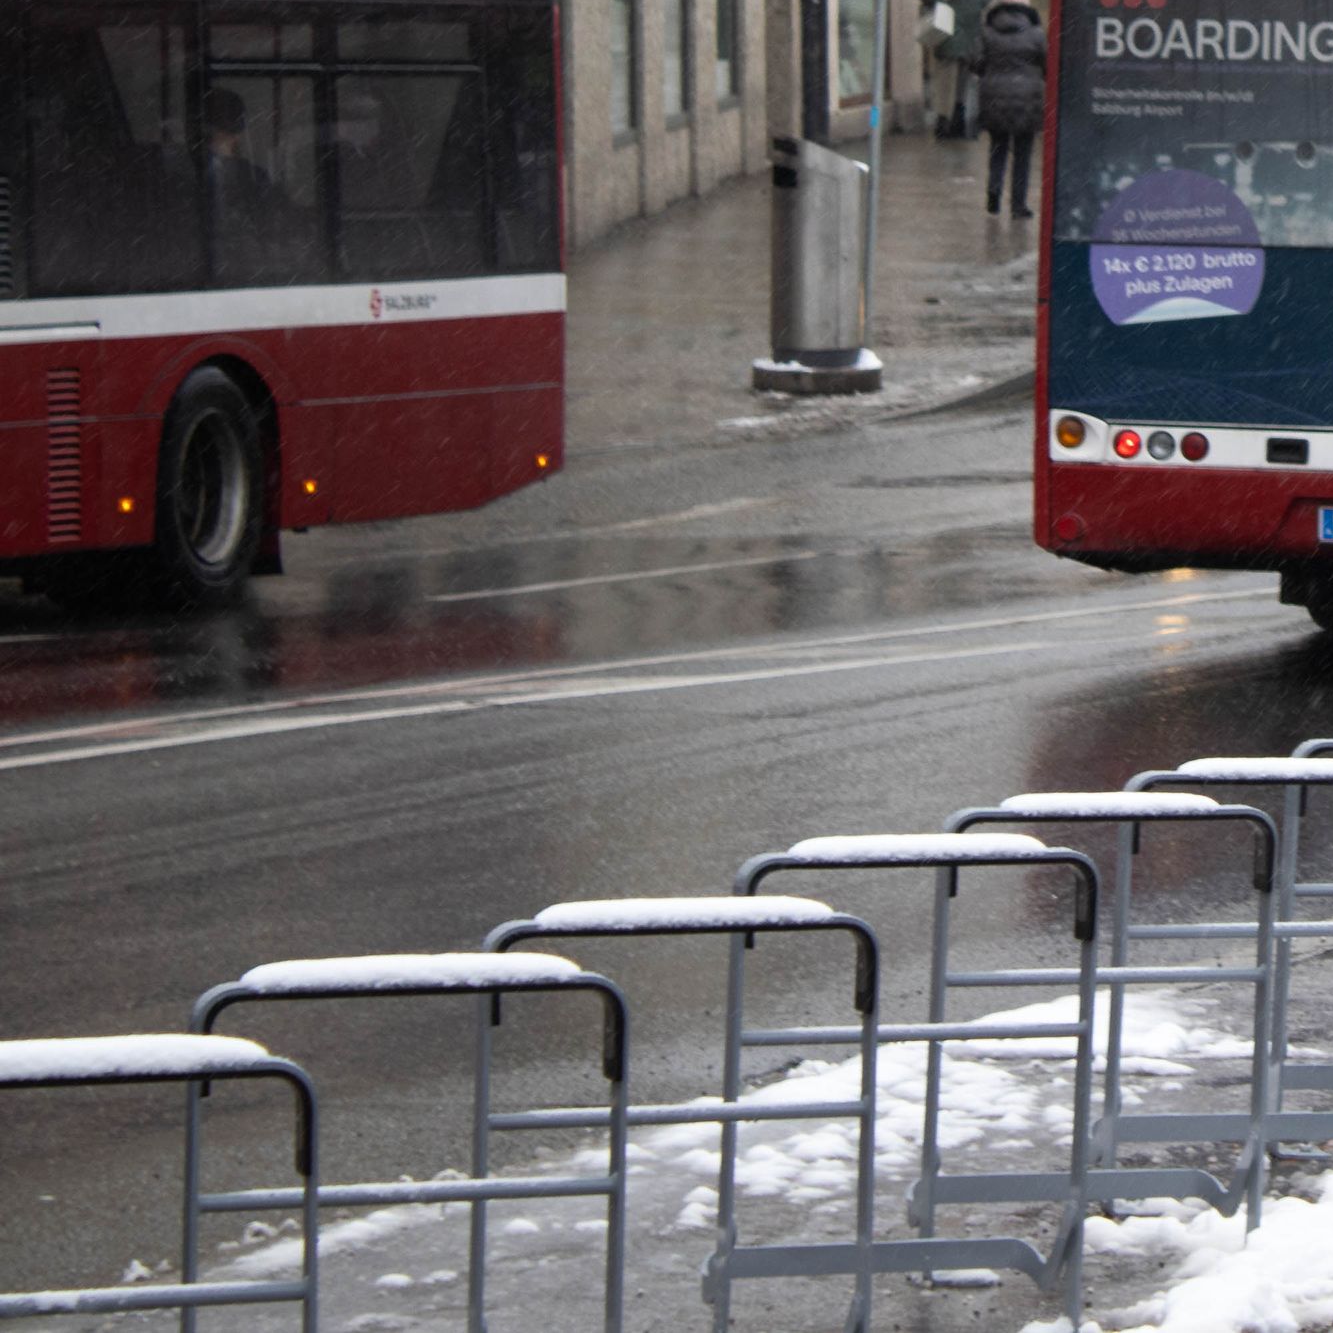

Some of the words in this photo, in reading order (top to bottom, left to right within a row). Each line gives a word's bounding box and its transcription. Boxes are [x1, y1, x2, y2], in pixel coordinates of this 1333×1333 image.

[1091, 102, 1141, 118] Salzburg
[1144, 104, 1184, 118] Airport
[1103, 257, 1132, 275] 14x
[1134, 255, 1149, 273] €
[1152, 253, 1196, 272] 2.120
[1202, 251, 1257, 268] brutto
[1125, 278, 1161, 298] plus
[1163, 274, 1234, 295] Zulagen
